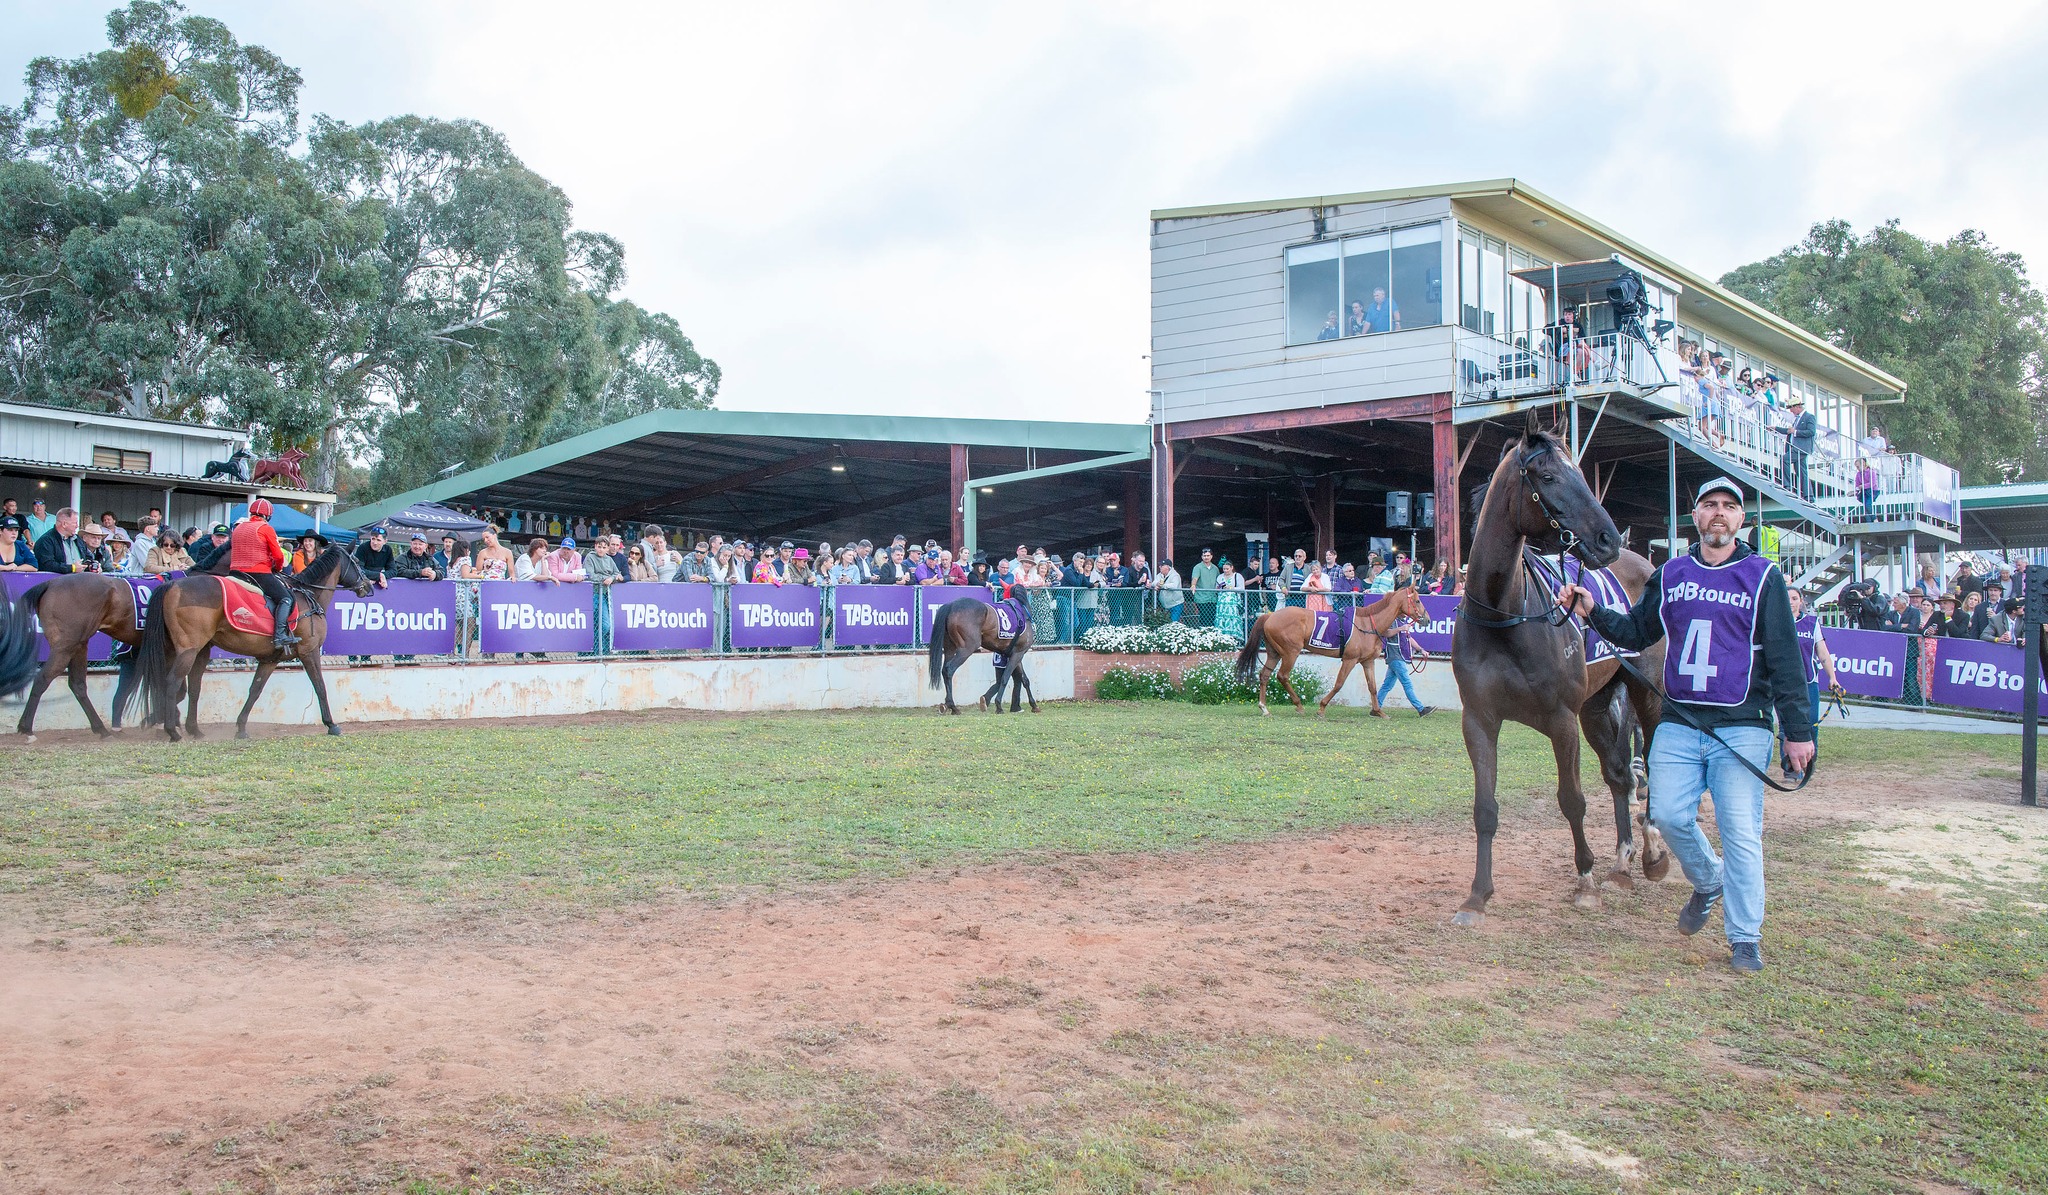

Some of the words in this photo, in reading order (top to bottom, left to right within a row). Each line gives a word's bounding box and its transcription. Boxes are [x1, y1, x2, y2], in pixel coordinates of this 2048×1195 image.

[404, 511, 470, 528] ROHAN
[1667, 581, 1752, 610] TABtouch
[334, 602, 447, 631] TABtouch
[491, 603, 587, 630] TABtouch
[621, 603, 707, 629] TABtouch
[739, 604, 815, 628] TABtouch
[842, 604, 909, 626] TABtouch
[997, 608, 1012, 631] 8
[1315, 616, 1329, 640] 7
[1678, 618, 1718, 692] 4
